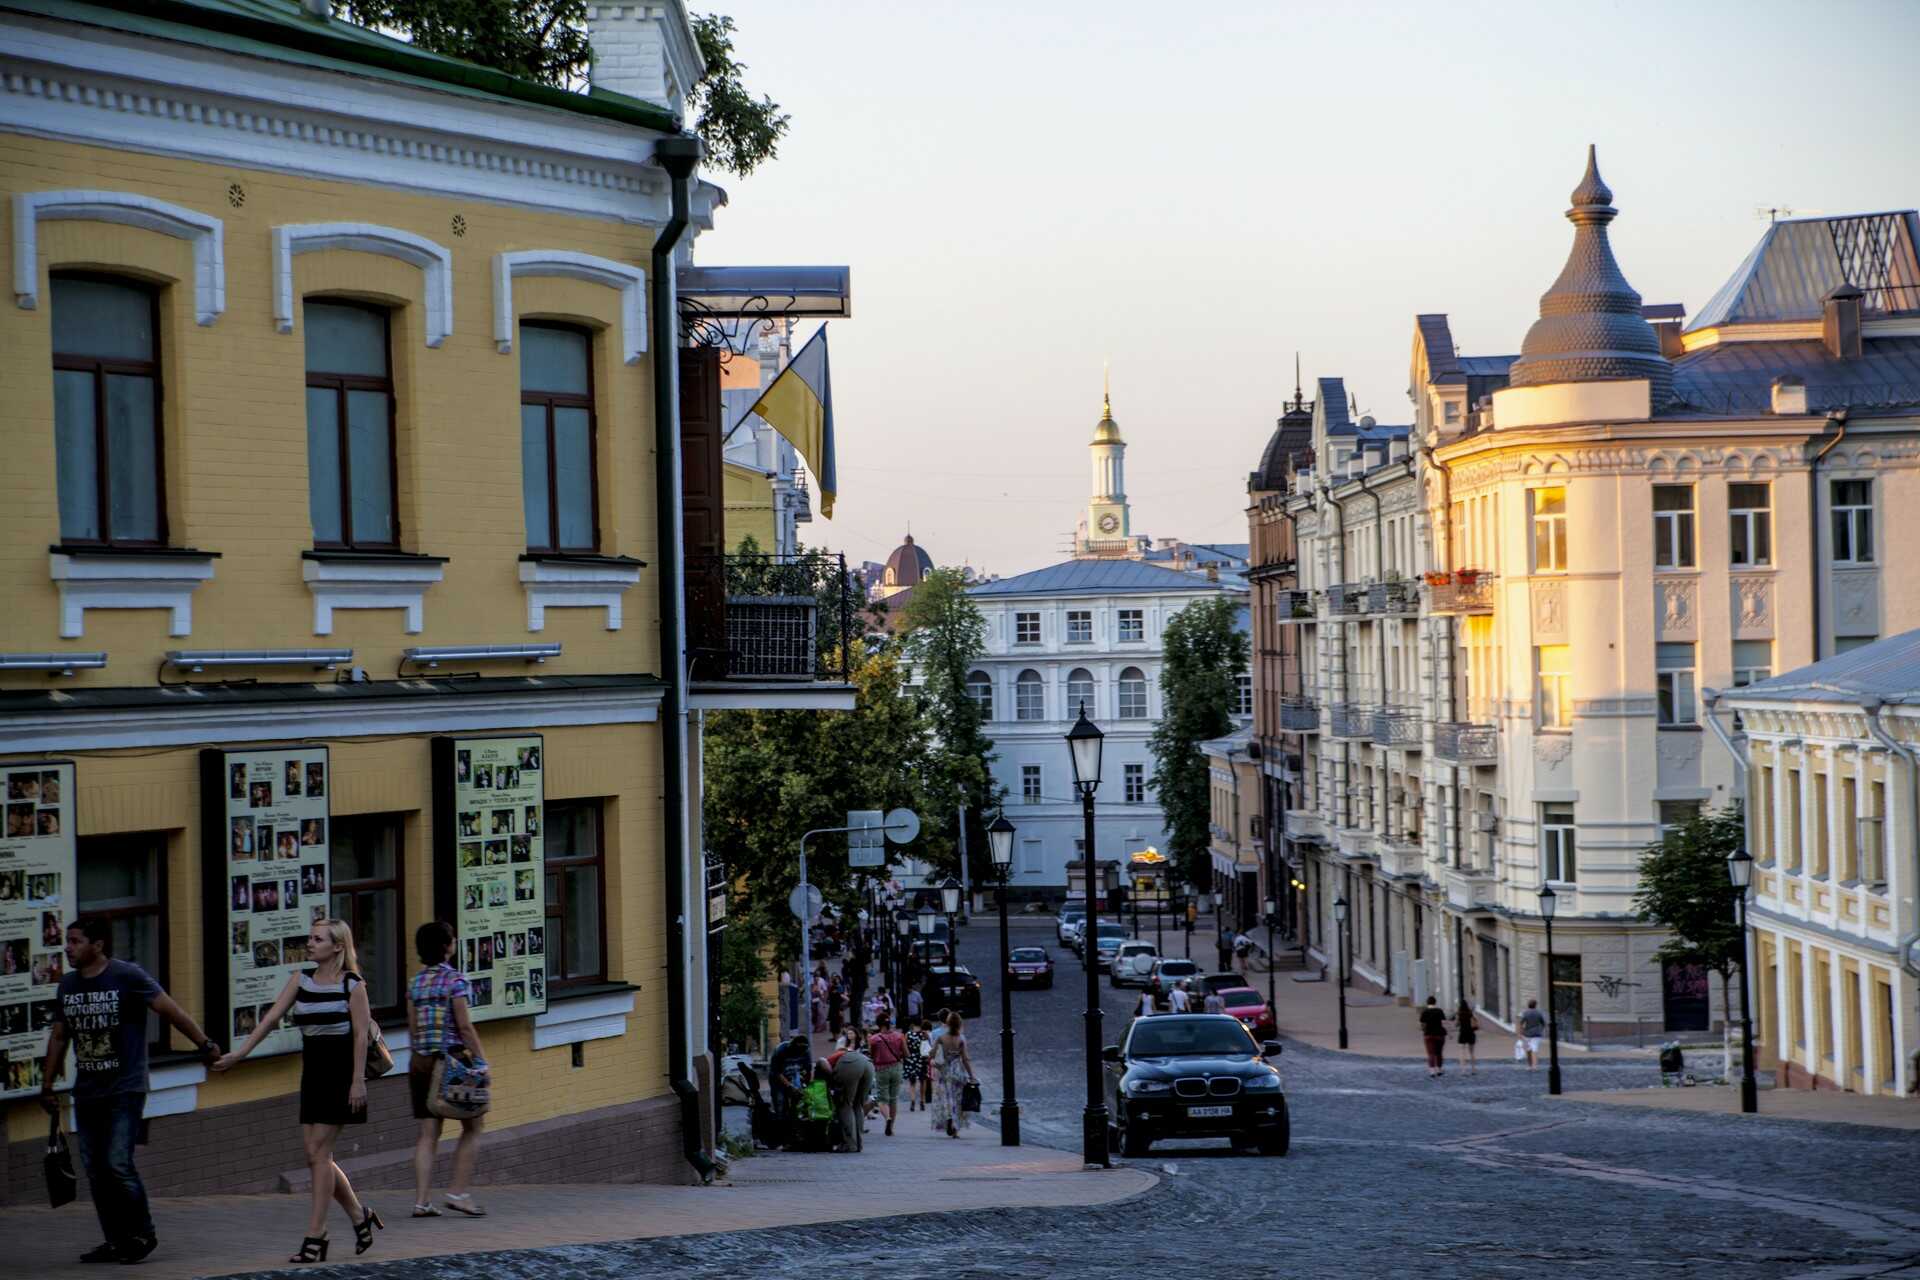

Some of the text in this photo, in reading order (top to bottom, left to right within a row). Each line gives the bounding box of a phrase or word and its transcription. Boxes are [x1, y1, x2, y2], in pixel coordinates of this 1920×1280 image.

[64, 990, 119, 1005] FAST TRACK
[64, 1001, 119, 1016] MOTORBIKE
